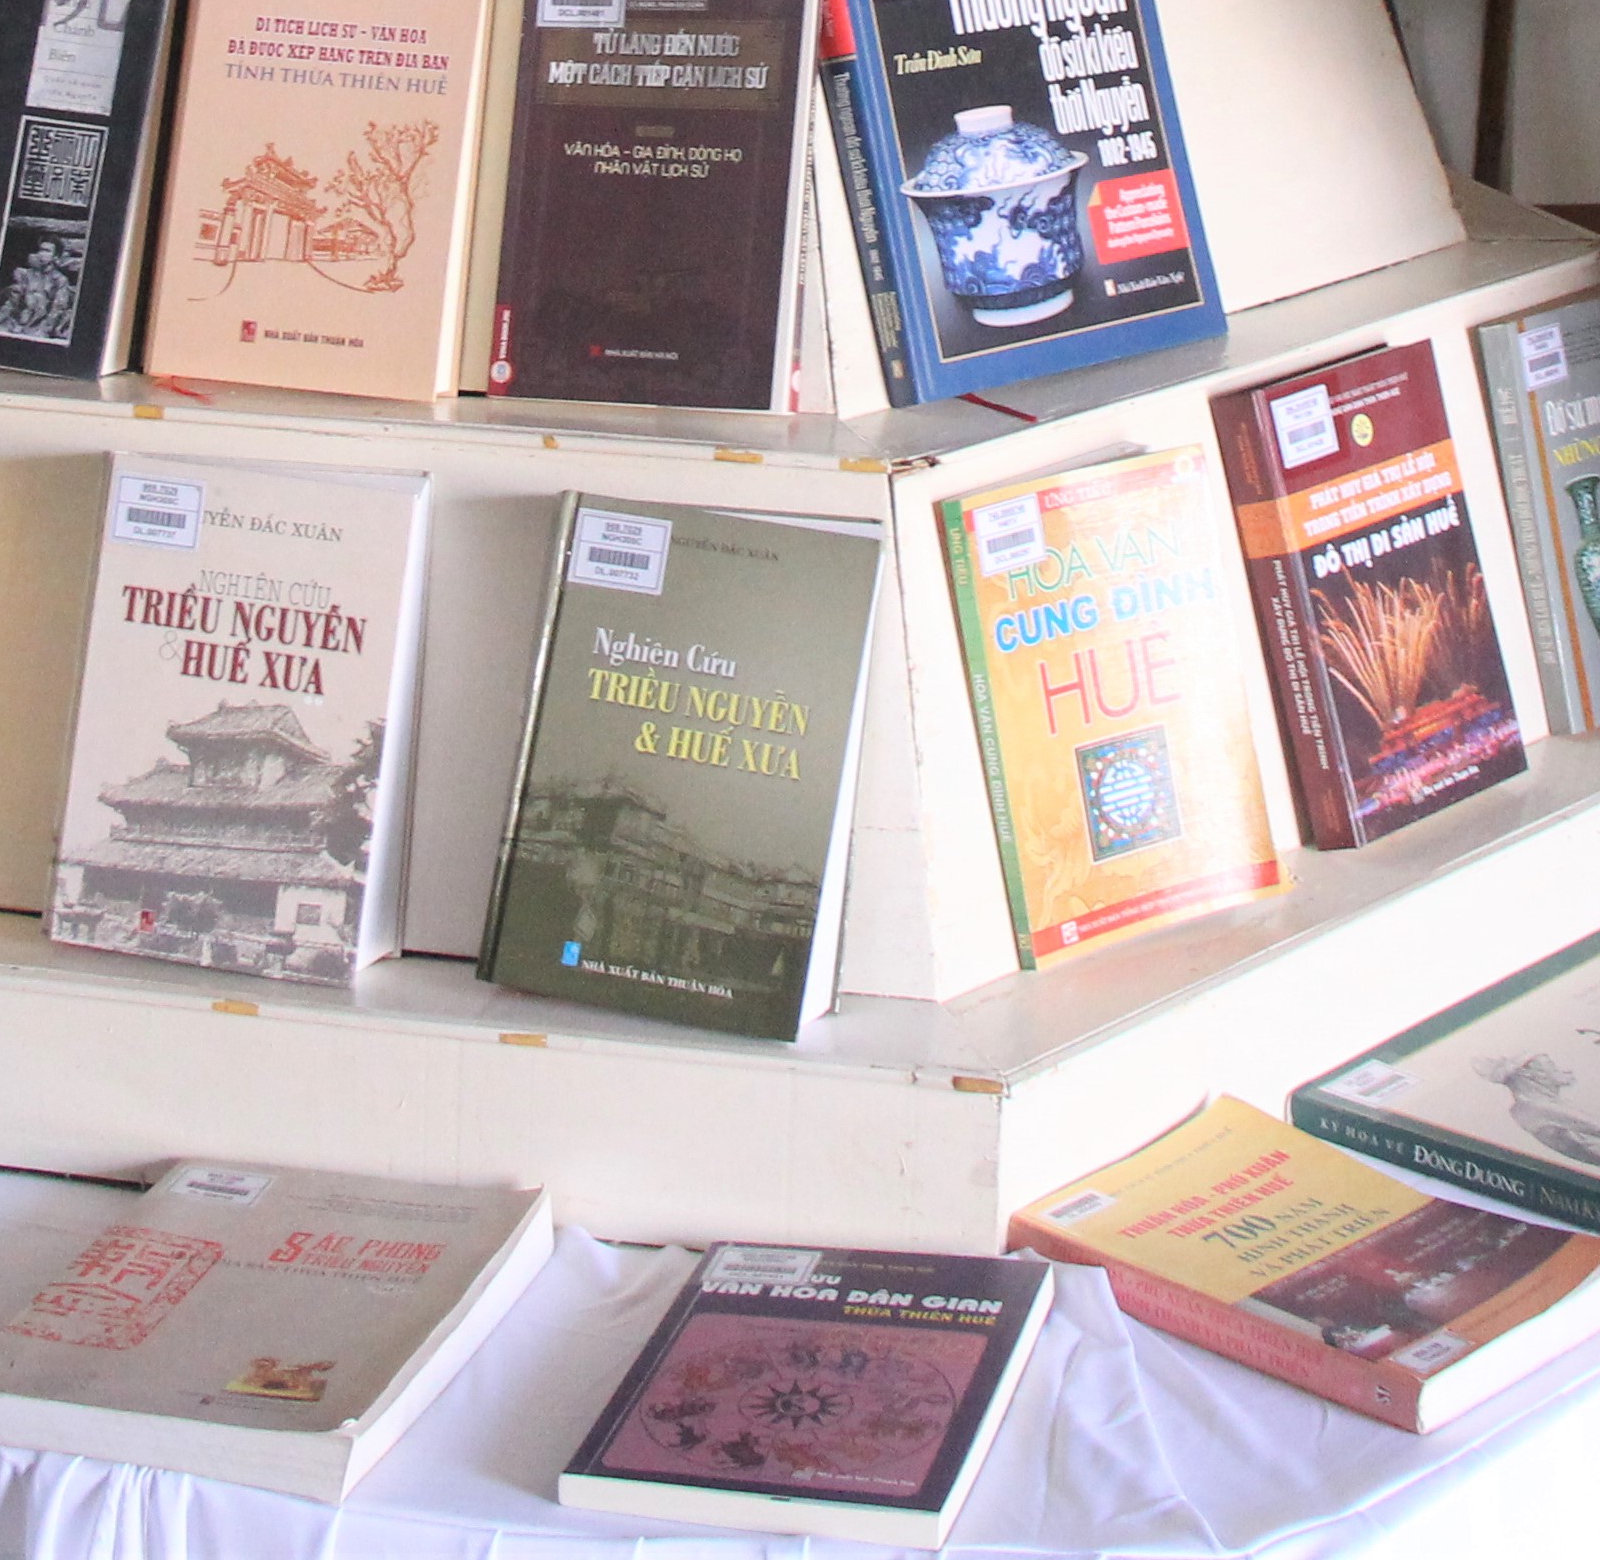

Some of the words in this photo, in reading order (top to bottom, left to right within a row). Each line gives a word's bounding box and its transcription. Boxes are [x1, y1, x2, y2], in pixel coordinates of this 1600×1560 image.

[256, 17, 271, 32] DI
[291, 521, 344, 542] XUÂN
[1008, 543, 1093, 600] HOA
[1096, 518, 1183, 571] VĂN
[1312, 543, 1342, 579] ĐÔ
[1340, 537, 1373, 568] THỊ
[1370, 530, 1392, 557] DI
[1390, 515, 1426, 549] SẢN
[1424, 493, 1460, 535] HUẾ
[122, 583, 223, 635] TRIỀU
[230, 600, 368, 655] NGUYỄN
[199, 569, 283, 602] NGHIÊN
[289, 578, 332, 609] CỨU
[995, 595, 1098, 652] CUNG
[1111, 567, 1216, 621] ĐÌNH
[159, 630, 183, 661] &
[180, 637, 252, 684] HUẾ
[258, 651, 324, 695] XƯA
[592, 626, 680, 668] Nghiên
[685, 643, 738, 679] Cứu
[1039, 620, 1182, 735] HUẾ
[588, 666, 681, 714] TRIỀU
[683, 686, 811, 738] NGUYỄN
[634, 721, 661, 755] &
[666, 725, 735, 768] HUẾ
[737, 738, 801, 782] XƯA
[1201, 1213, 1277, 1251] 700
[847, 1287, 914, 1307] DÂN
[921, 1294, 1003, 1315] GIAN
